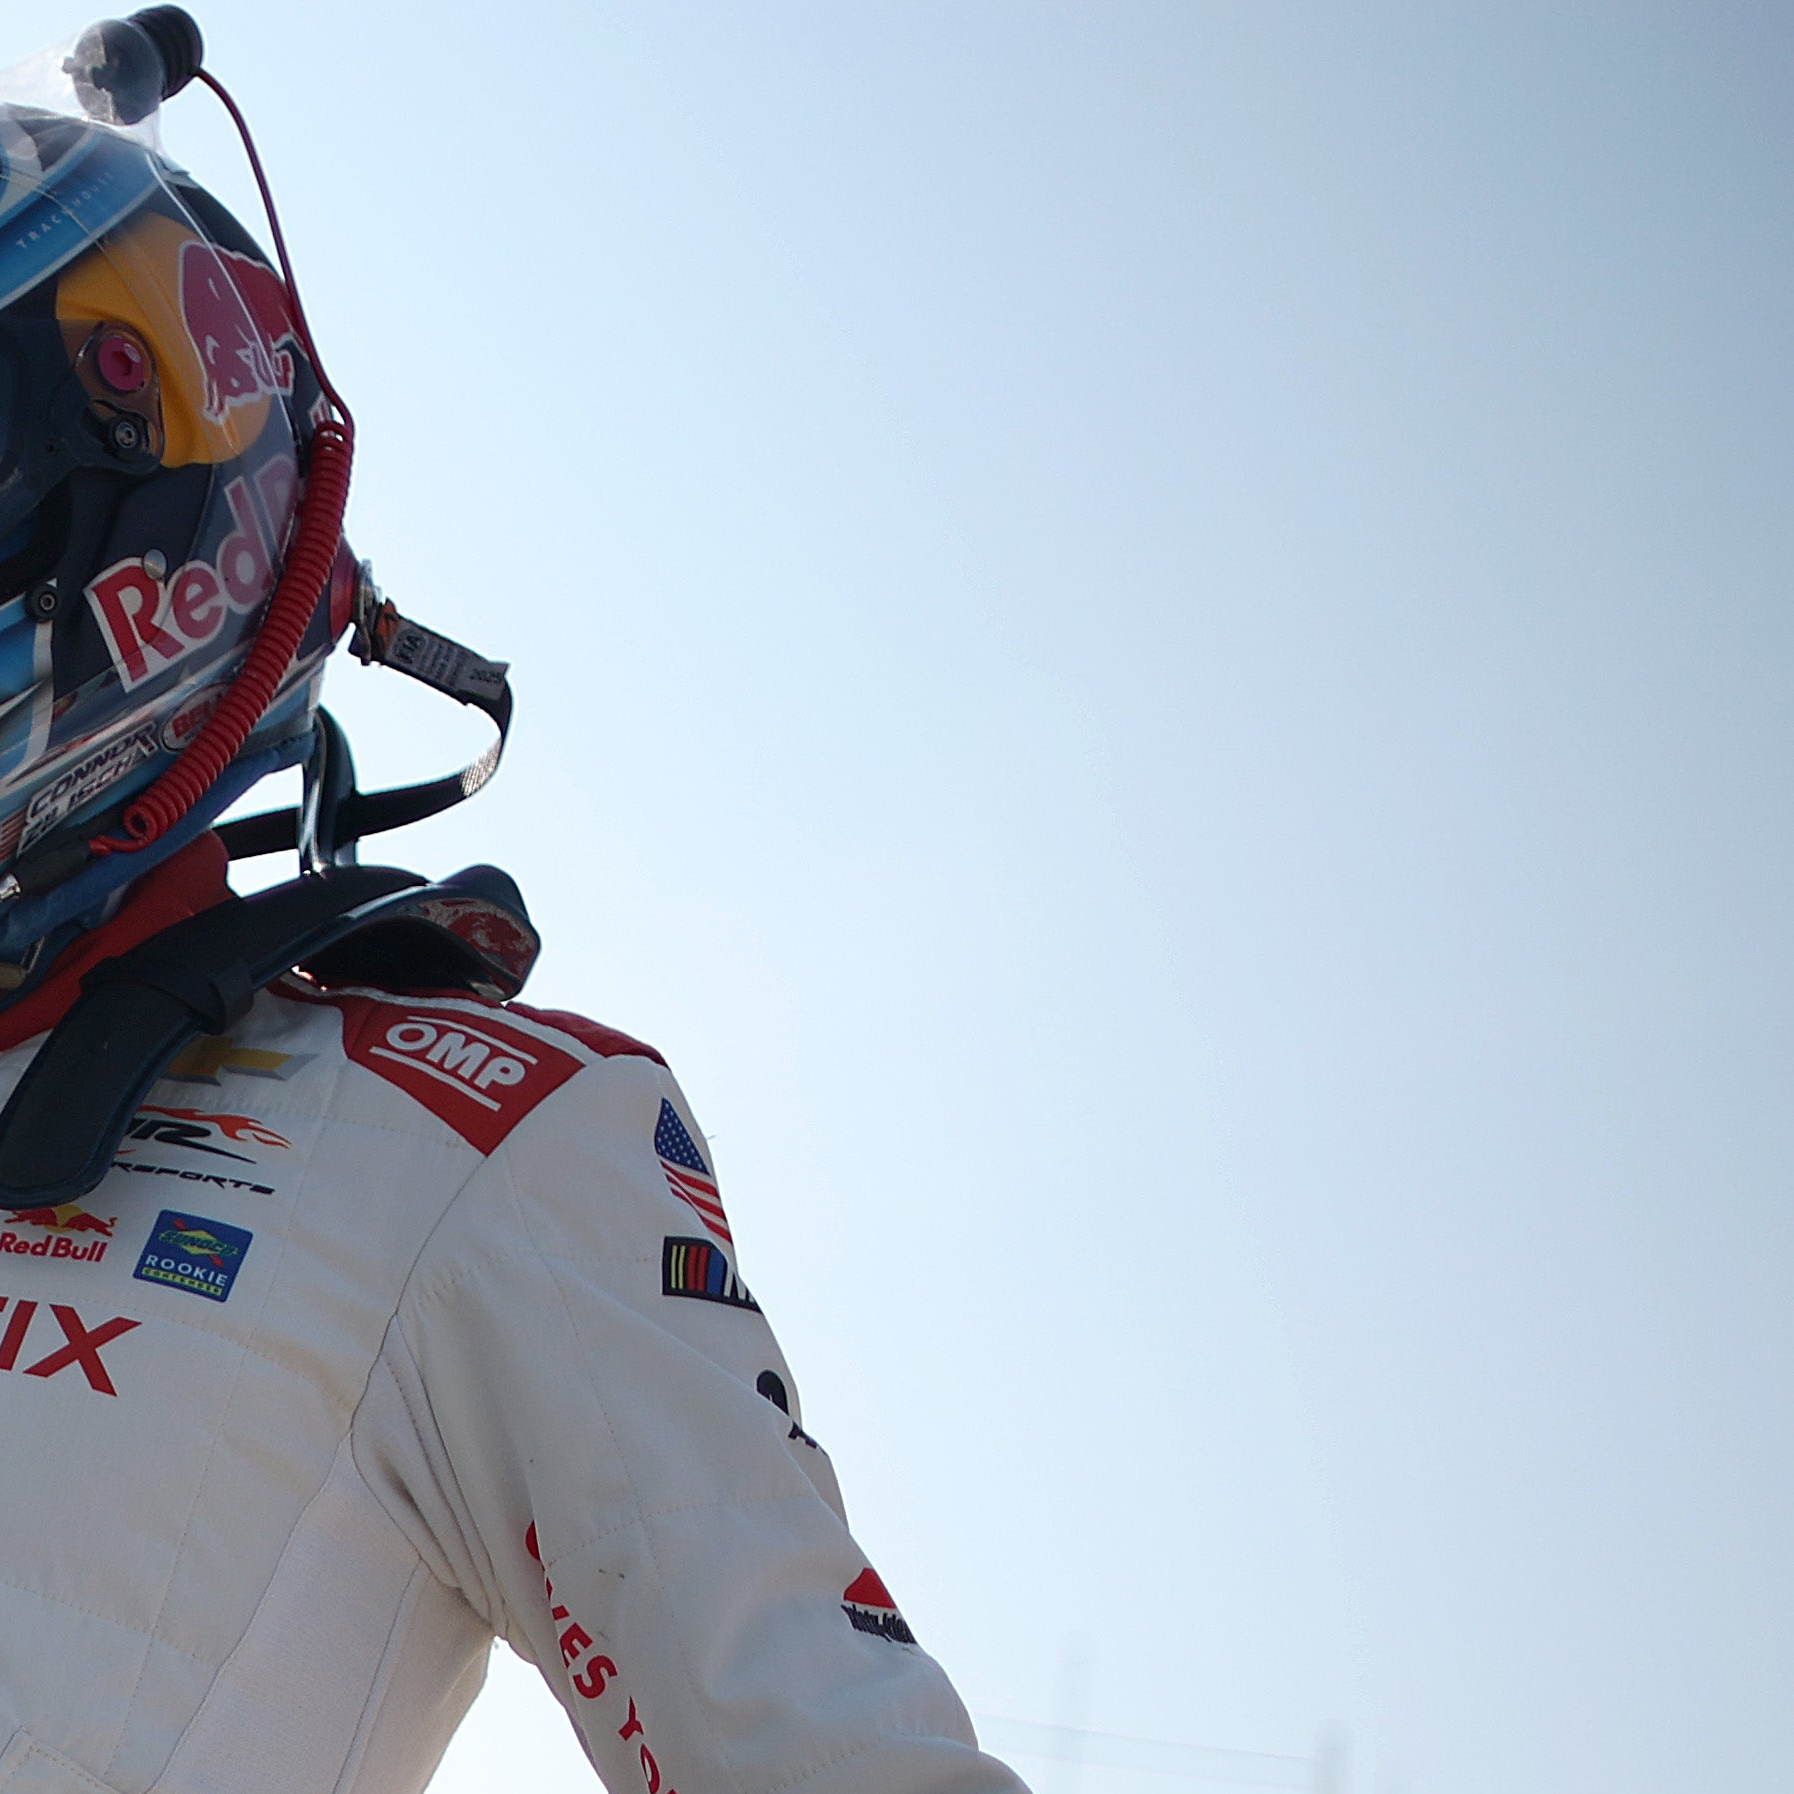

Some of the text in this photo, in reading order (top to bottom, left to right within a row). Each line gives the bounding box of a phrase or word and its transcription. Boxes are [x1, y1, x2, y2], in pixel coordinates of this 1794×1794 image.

[85, 475, 276, 690] Red
[385, 1021, 527, 1090] OMP
[50, 1237, 108, 1263] Bull
[144, 1254, 229, 1287] ROOKIE
